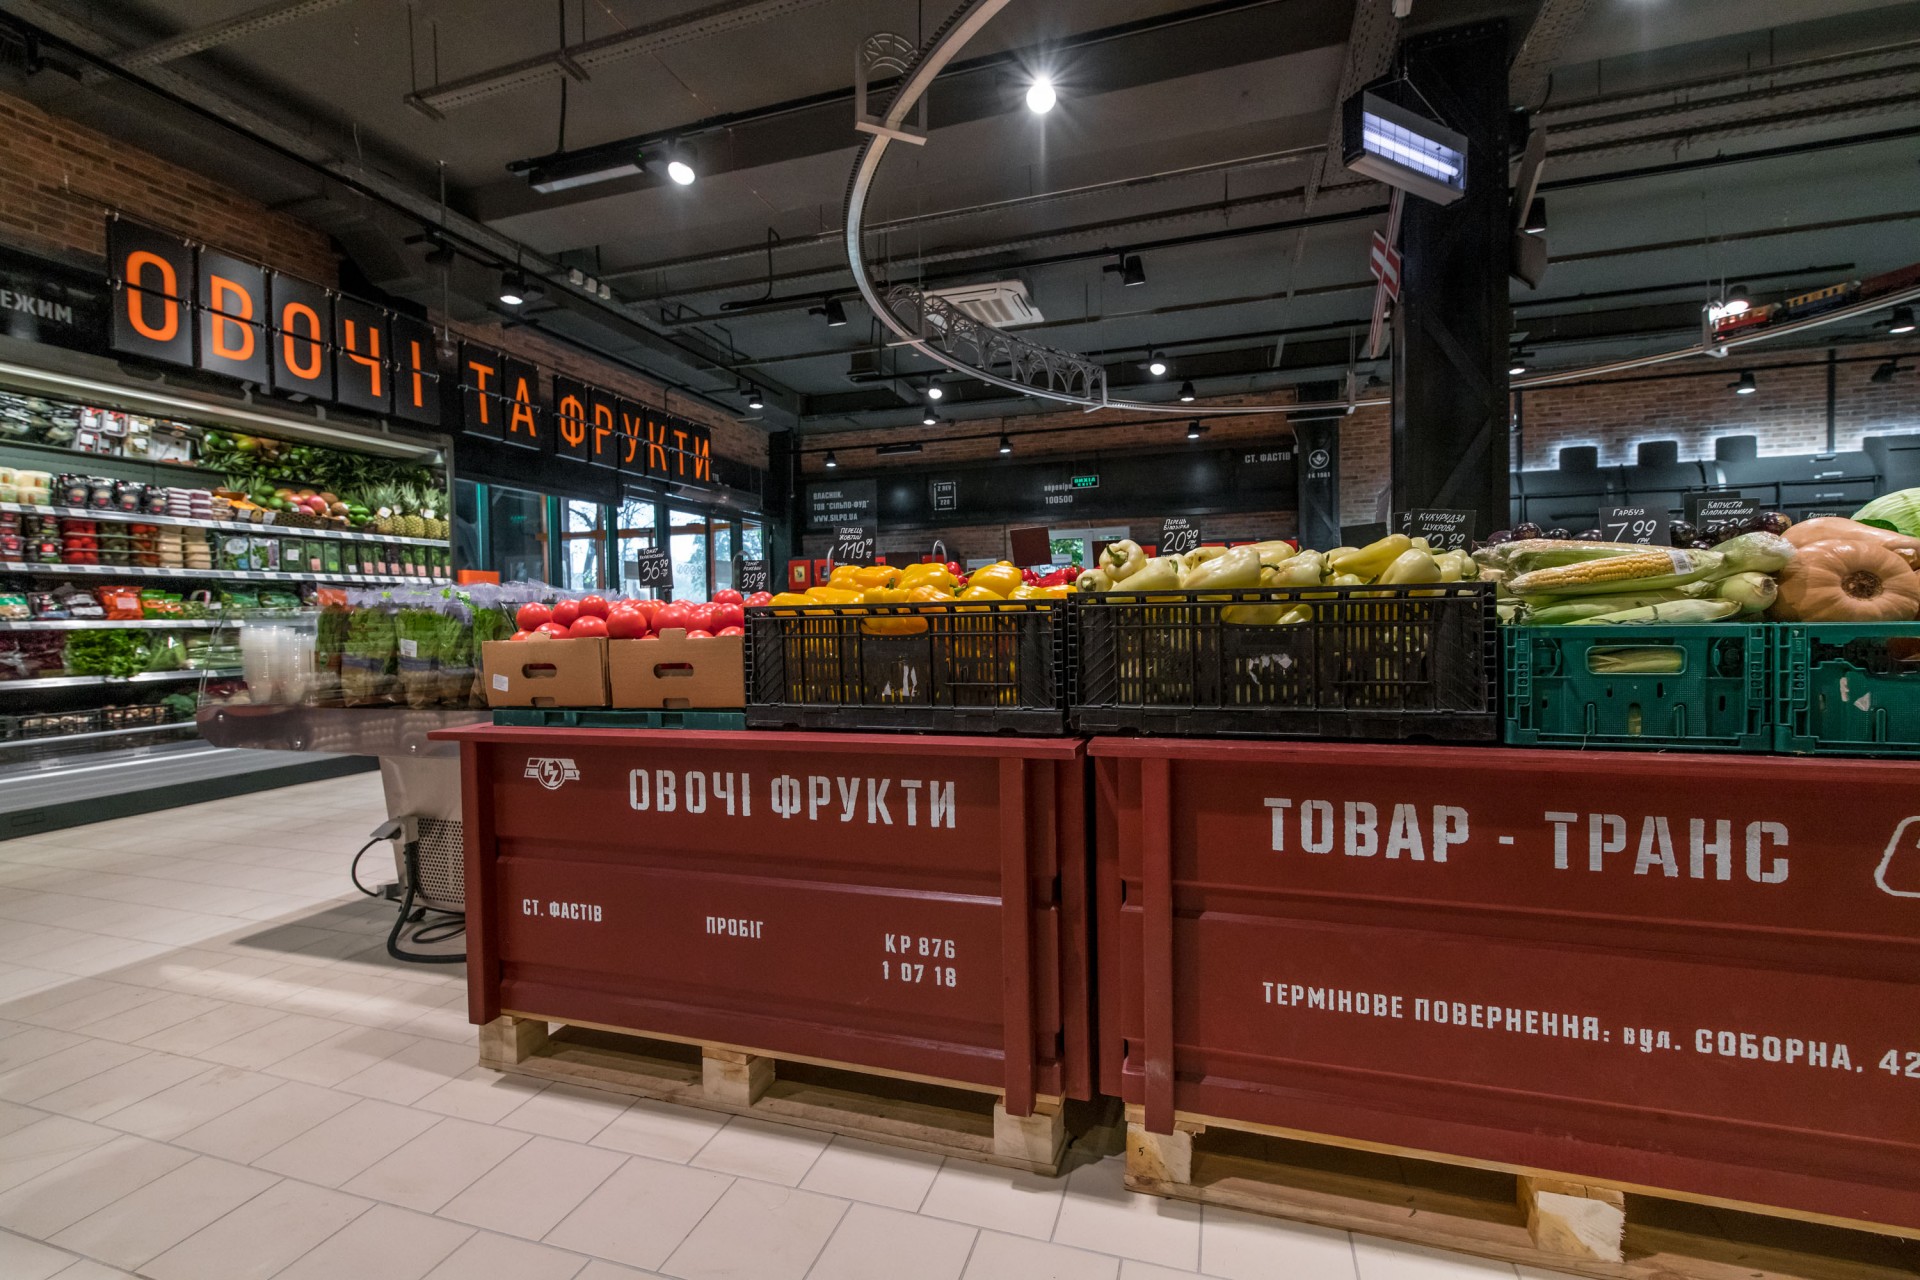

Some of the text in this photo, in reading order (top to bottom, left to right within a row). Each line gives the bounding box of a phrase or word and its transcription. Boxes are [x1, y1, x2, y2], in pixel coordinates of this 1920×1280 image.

[126, 251, 709, 481] ОВОЧІ ТА ФРУКТИ
[1260, 452, 1290, 461] ФАСТІВ
[814, 503, 825, 511] ТОВ
[1045, 495, 1073, 504] 100500
[814, 513, 858, 522] WWW.SILPO.UA
[1419, 513, 1466, 523] КУКУРУДЗА
[1613, 508, 1645, 516] ГАРБУЗ
[1423, 523, 1456, 532] ЦУКРОВА
[1449, 533, 1466, 544] 99
[1607, 522, 1628, 543] 7
[1633, 520, 1657, 536] 99
[838, 541, 865, 559] 119
[865, 538, 873, 546] 99
[1163, 531, 1187, 552] 20
[1187, 530, 1199, 540] 99
[642, 560, 660, 582] 36
[660, 558, 669, 569] 99
[741, 572, 756, 589] 39
[757, 572, 767, 582] 99
[629, 768, 956, 829] ОВОЧІ ФРУКТИ
[1264, 797, 1469, 863] ТОВАР
[1544, 811, 1789, 884] ТРАНС
[522, 899, 602, 922] СТ. ФАСТІВ
[706, 916, 764, 940] ПРОБІГ
[918, 937, 956, 959] 876
[882, 960, 957, 988] 1 07 18
[1262, 981, 1403, 1019] ТЕРМІНОВЕ
[1415, 997, 1611, 1043] ПОВЕРНЕННЯ:
